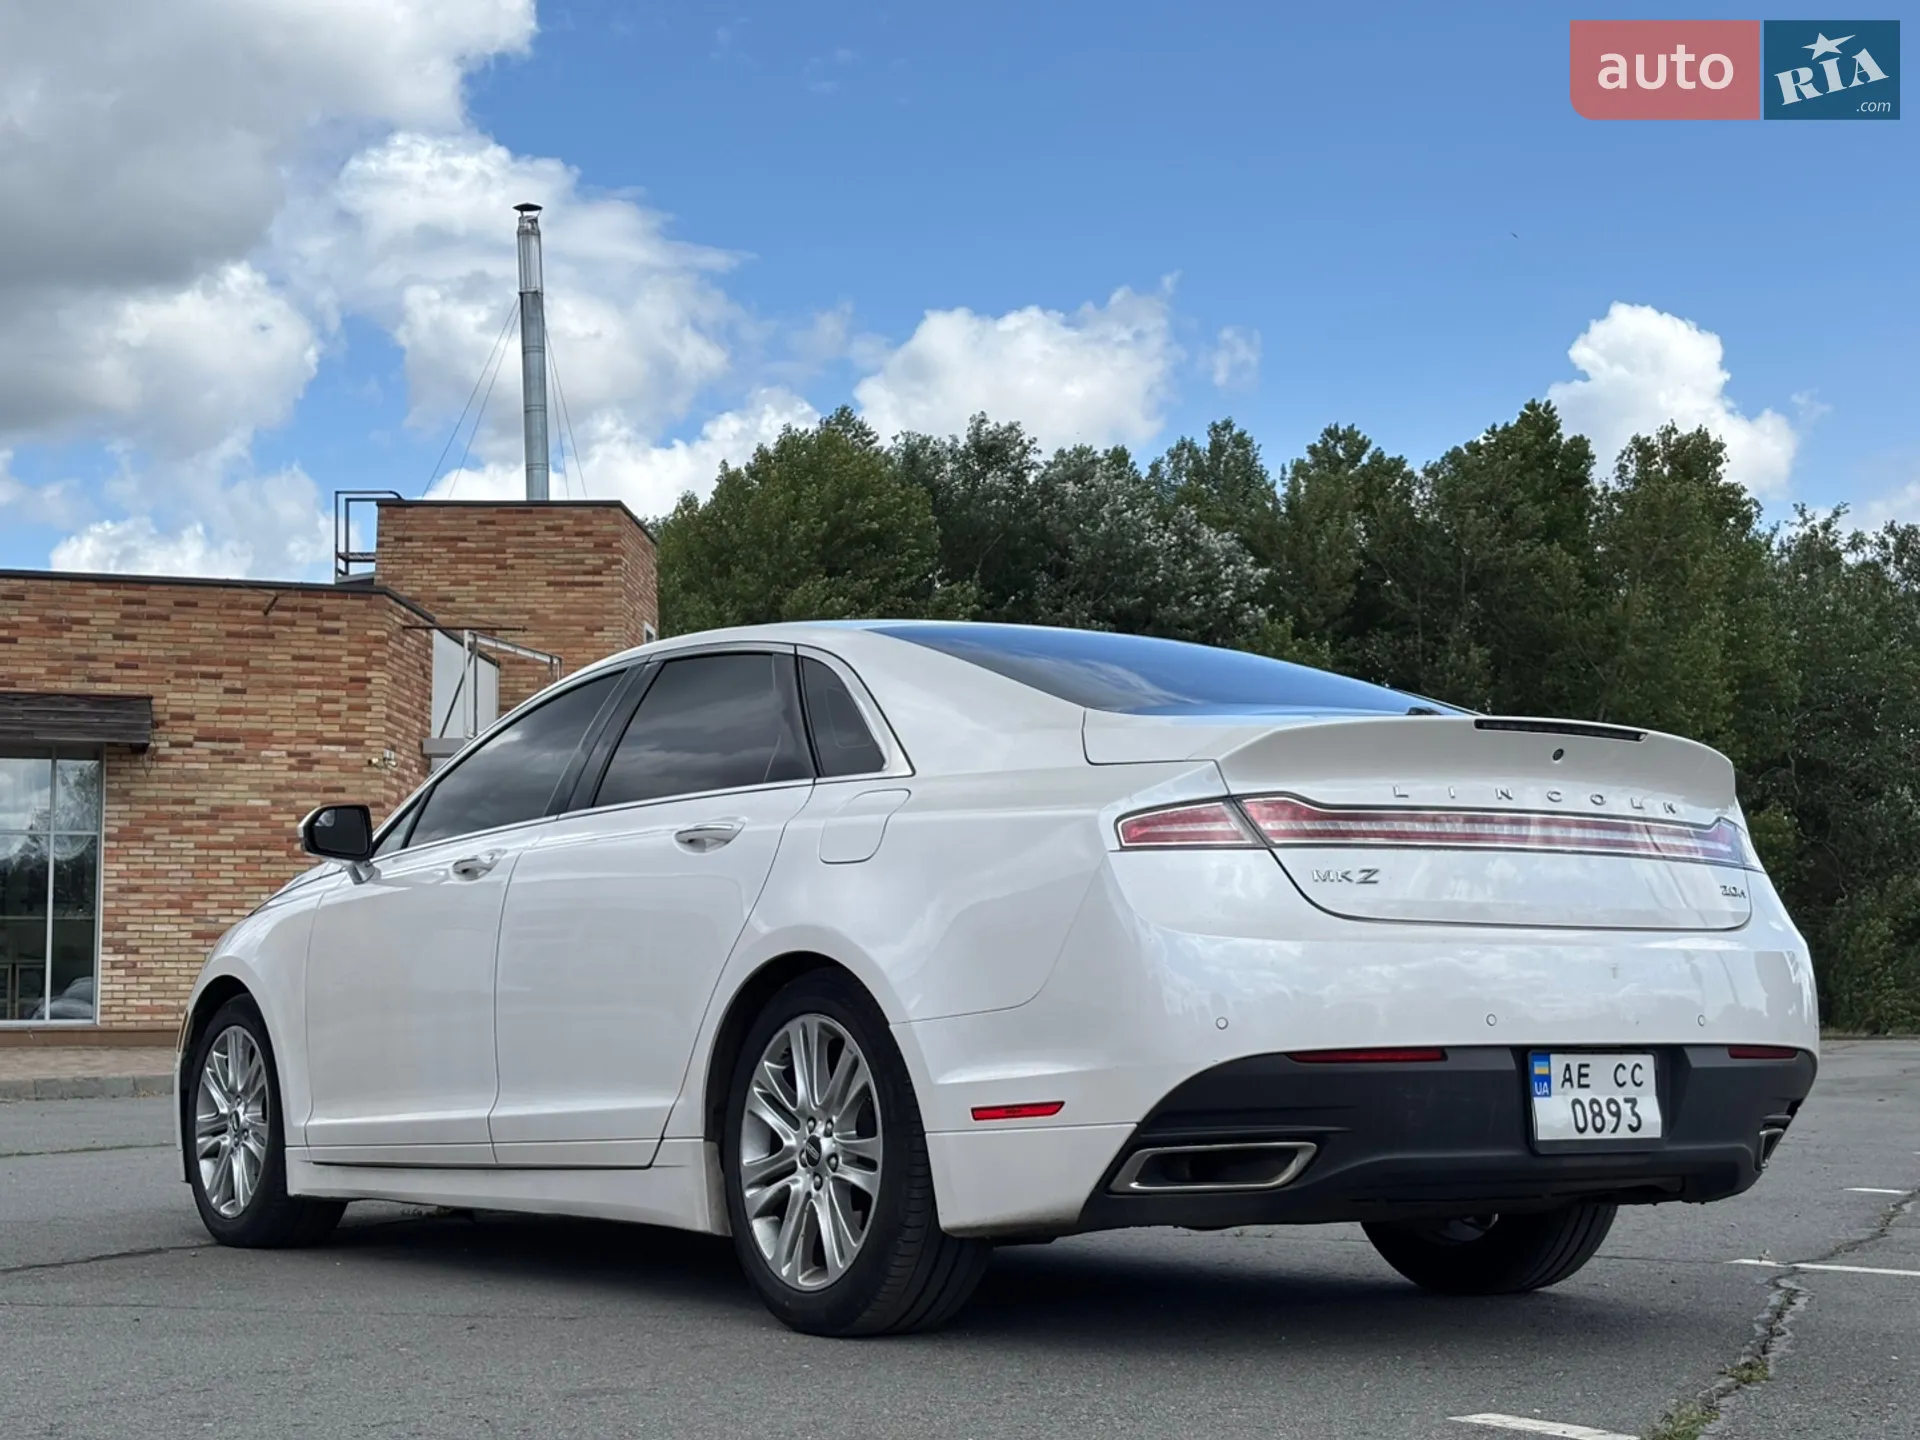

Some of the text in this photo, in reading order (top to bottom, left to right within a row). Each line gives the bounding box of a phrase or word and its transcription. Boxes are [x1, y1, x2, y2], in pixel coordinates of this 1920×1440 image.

[1393, 784, 1677, 815] LINCOLN
[1312, 868, 1380, 885] MKZ
[1535, 1081, 1549, 1095] UA
[1561, 1062, 1644, 1089] AE CC
[1571, 1097, 1642, 1134] 0893
